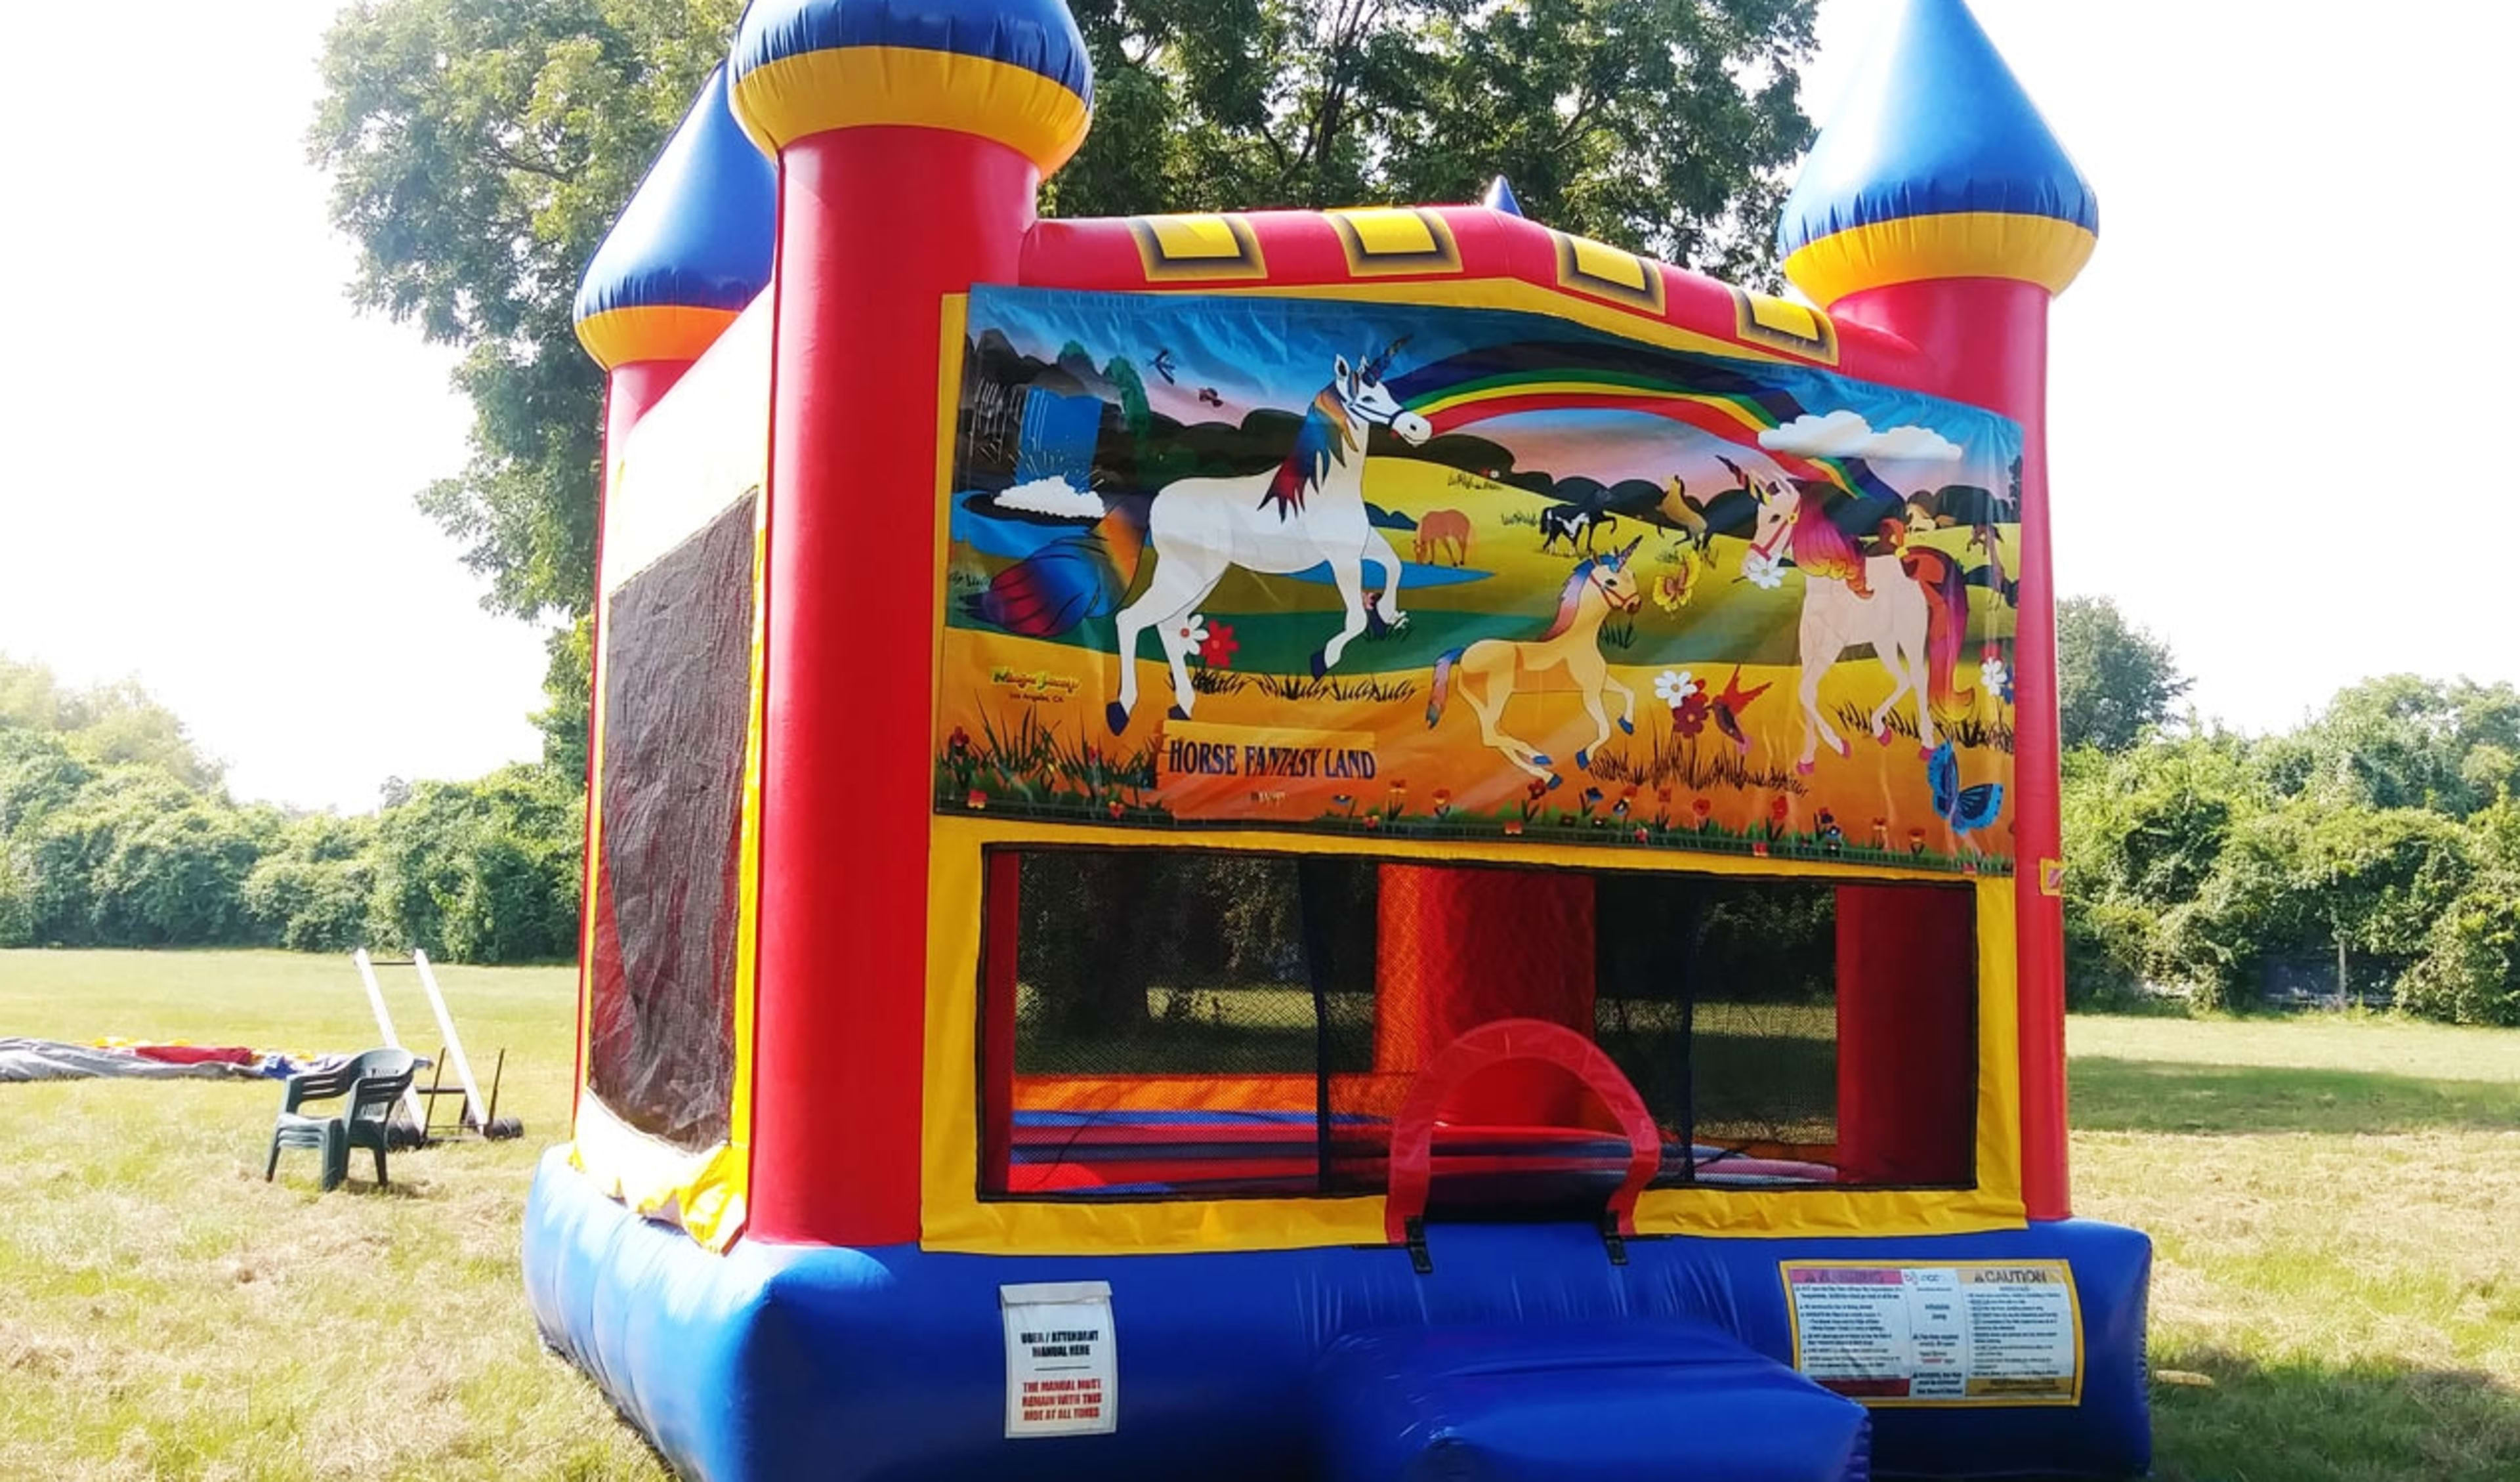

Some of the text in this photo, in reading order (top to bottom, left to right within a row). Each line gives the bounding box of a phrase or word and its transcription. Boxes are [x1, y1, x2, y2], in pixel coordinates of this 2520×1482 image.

[1168, 740, 1376, 780] HORSE FANTASY LAND
[1984, 1269, 2048, 1283] CAUTION
[1023, 1382, 1038, 1393] THE
[1040, 1380, 1075, 1391] MANUAL
[1057, 1394, 1080, 1405] WITH
[1083, 1393, 1102, 1404] THIS
[1045, 1408, 1056, 1420] AT
[1057, 1408, 1072, 1419] ALL
